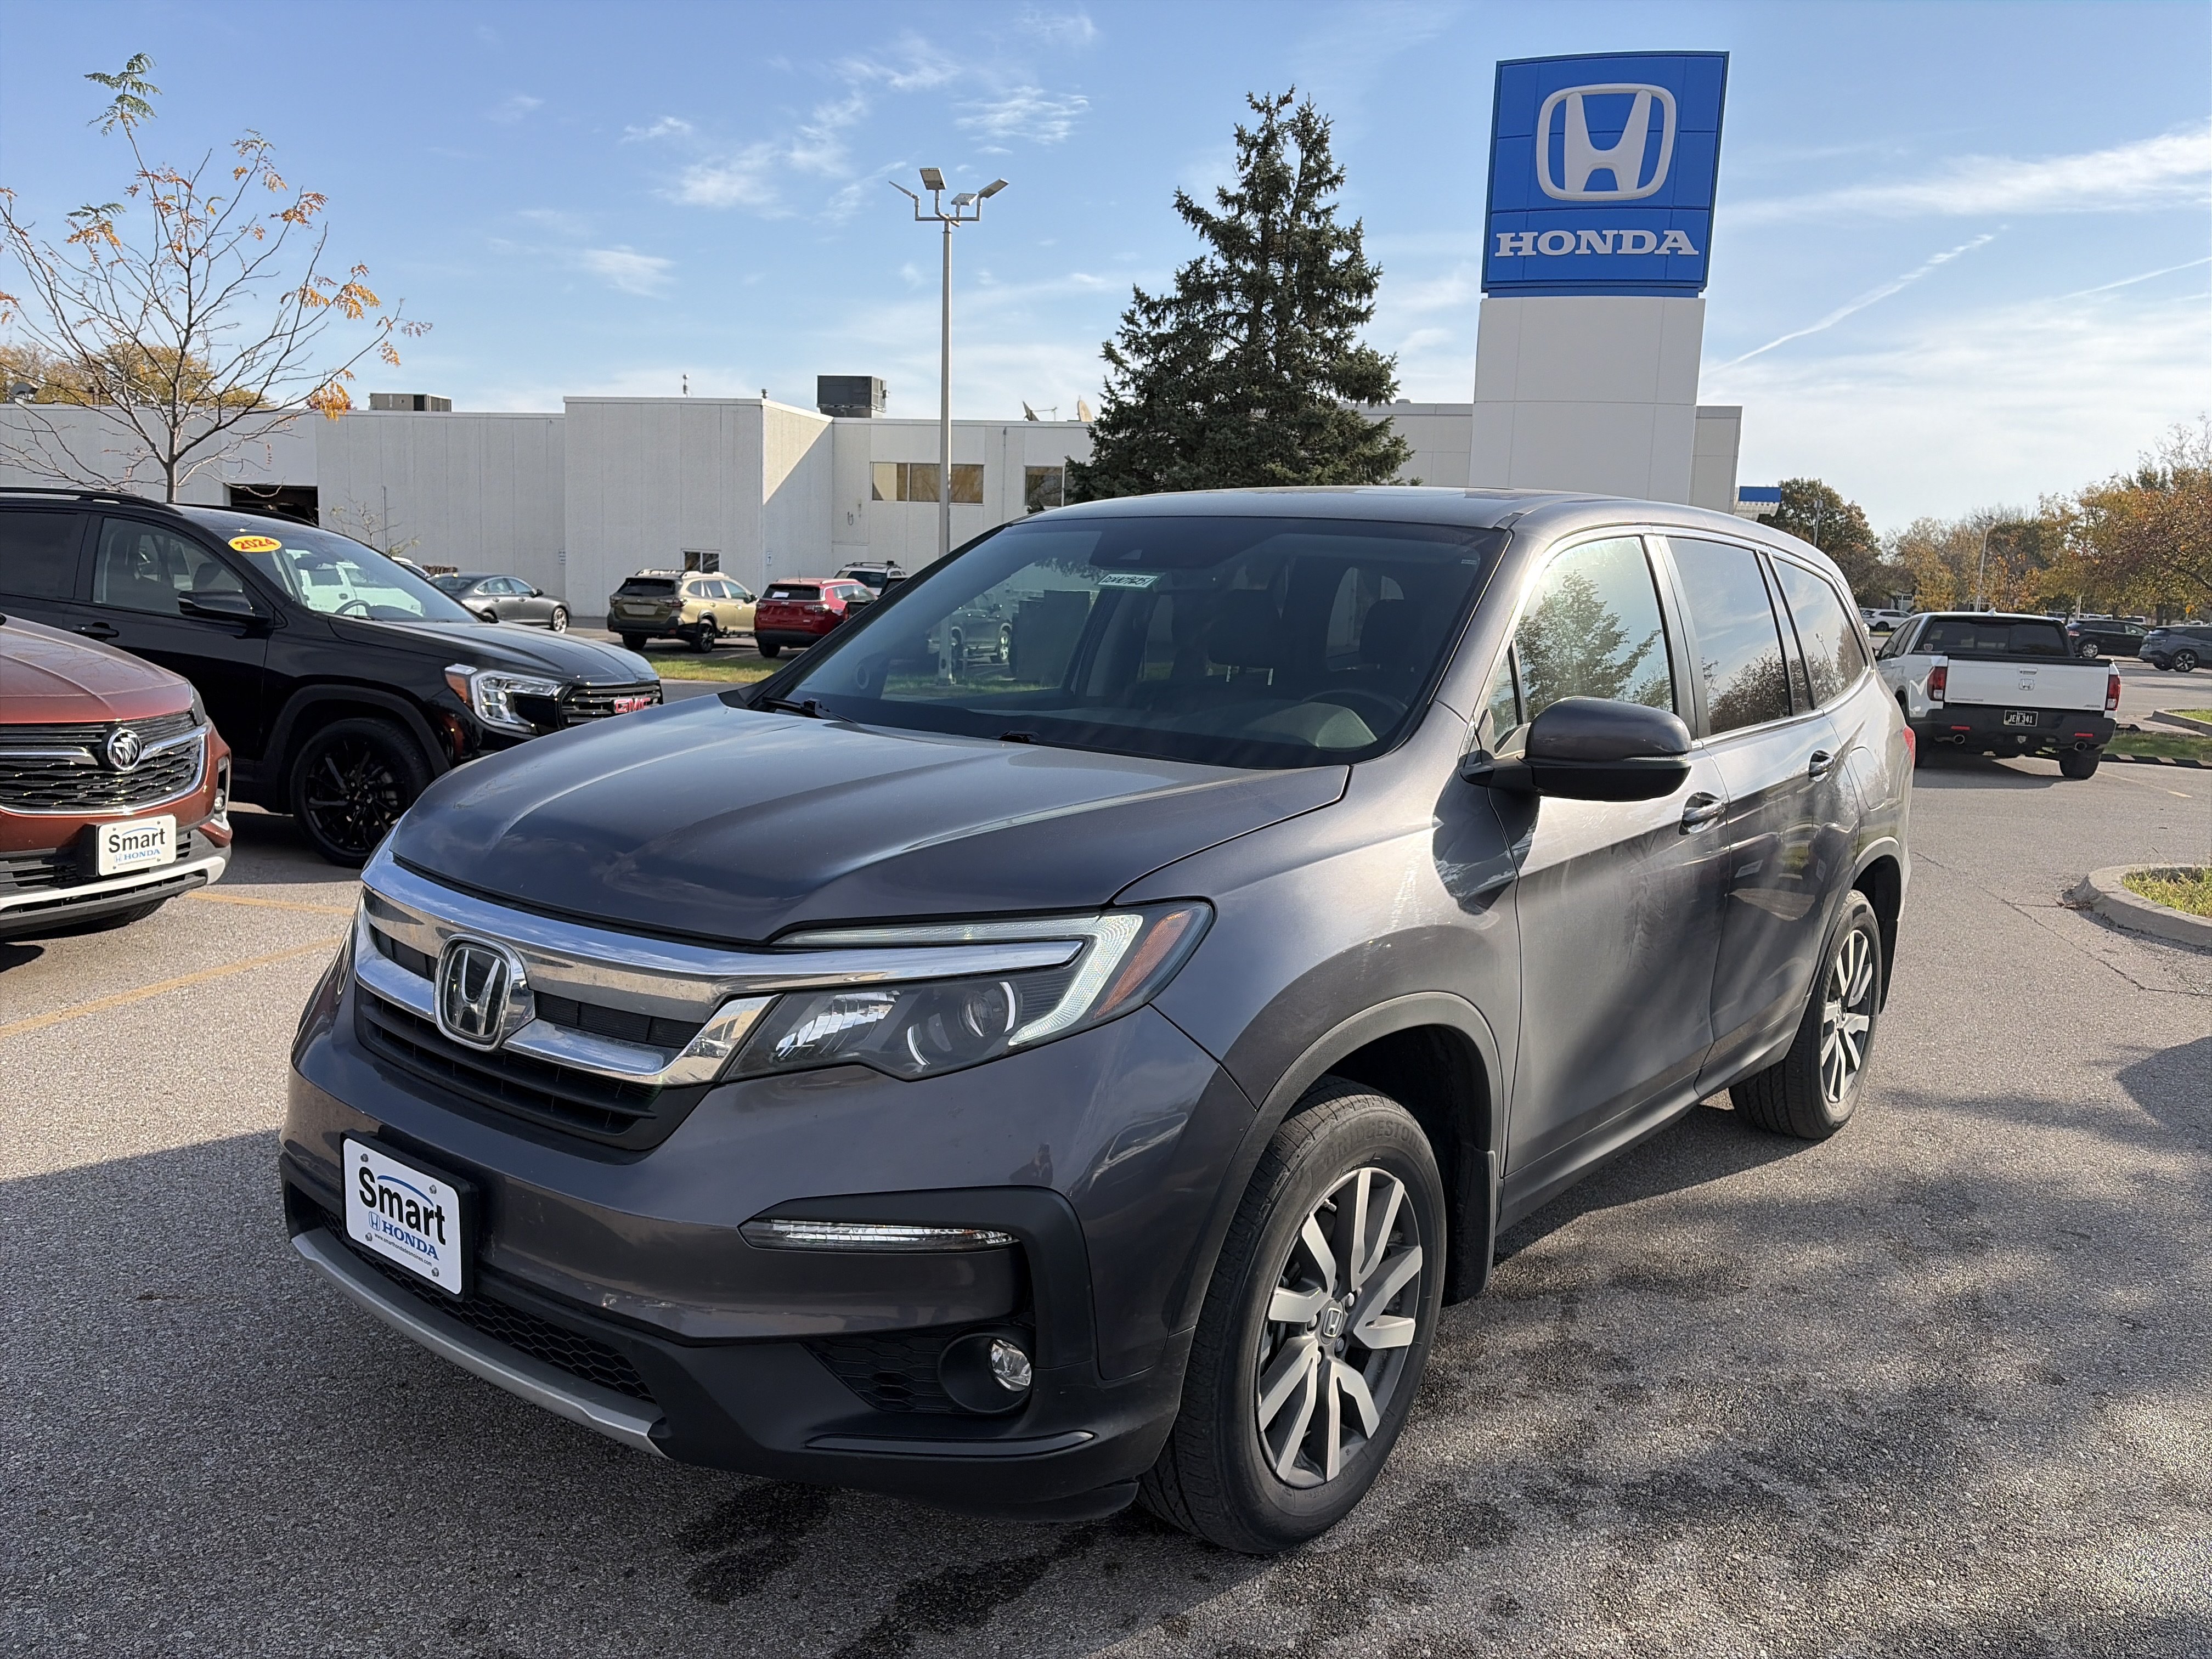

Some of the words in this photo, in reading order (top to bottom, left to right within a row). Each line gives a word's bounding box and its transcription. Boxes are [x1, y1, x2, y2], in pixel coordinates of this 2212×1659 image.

[1494, 229, 1699, 257] HONDA
[234, 538, 277, 550] 2024
[108, 828, 166, 854] Smart
[123, 848, 161, 861] HONDA
[358, 1166, 446, 1246] Smart
[381, 1219, 440, 1262] HONDA
